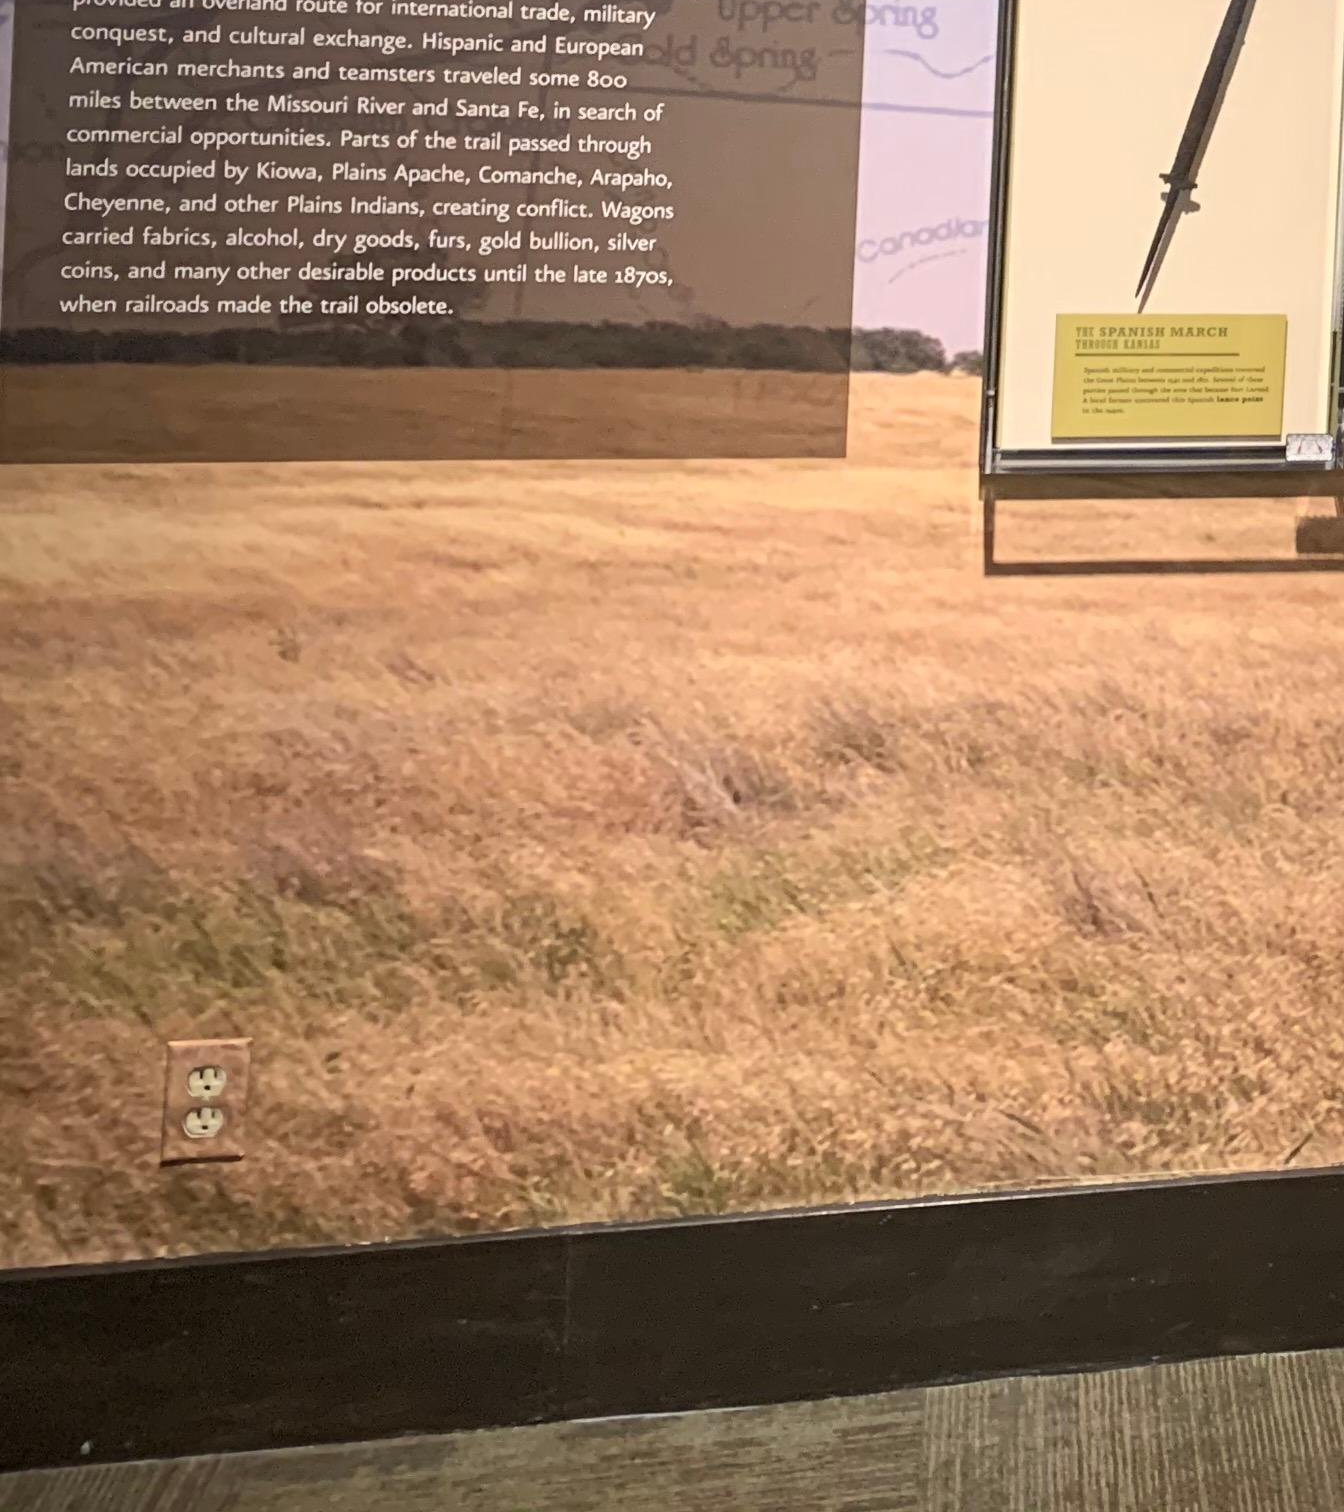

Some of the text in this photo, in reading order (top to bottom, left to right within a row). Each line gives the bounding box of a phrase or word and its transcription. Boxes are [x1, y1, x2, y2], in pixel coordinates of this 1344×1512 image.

[520, 2, 575, 24] trade,
[584, 3, 656, 30] military
[71, 24, 643, 61] conquest, and cultural exchange. Hispanic and European
[70, 56, 627, 88] American merchants and teamsters traveled some 800
[69, 90, 664, 122] miles between the Missouri River and Santa Fe, in search of
[67, 125, 651, 160] commercial opportunities. Parts of the trail passed through
[66, 157, 672, 192] lands occupied by Kiowa, Plains Apache, Comanche, Arapaho,
[65, 192, 674, 226] Cheyenne, and other Plains Indians, creating conflict. Wagons
[62, 225, 656, 256] carried fabrics, alcohol, dry goods, furs, gold bullion, silver
[61, 260, 672, 288] coins, and many other desirable products until the late 1870s,
[60, 294, 453, 315] when railroads made the trail obsolete.
[1099, 327, 1229, 338] SPANISH MARCH
